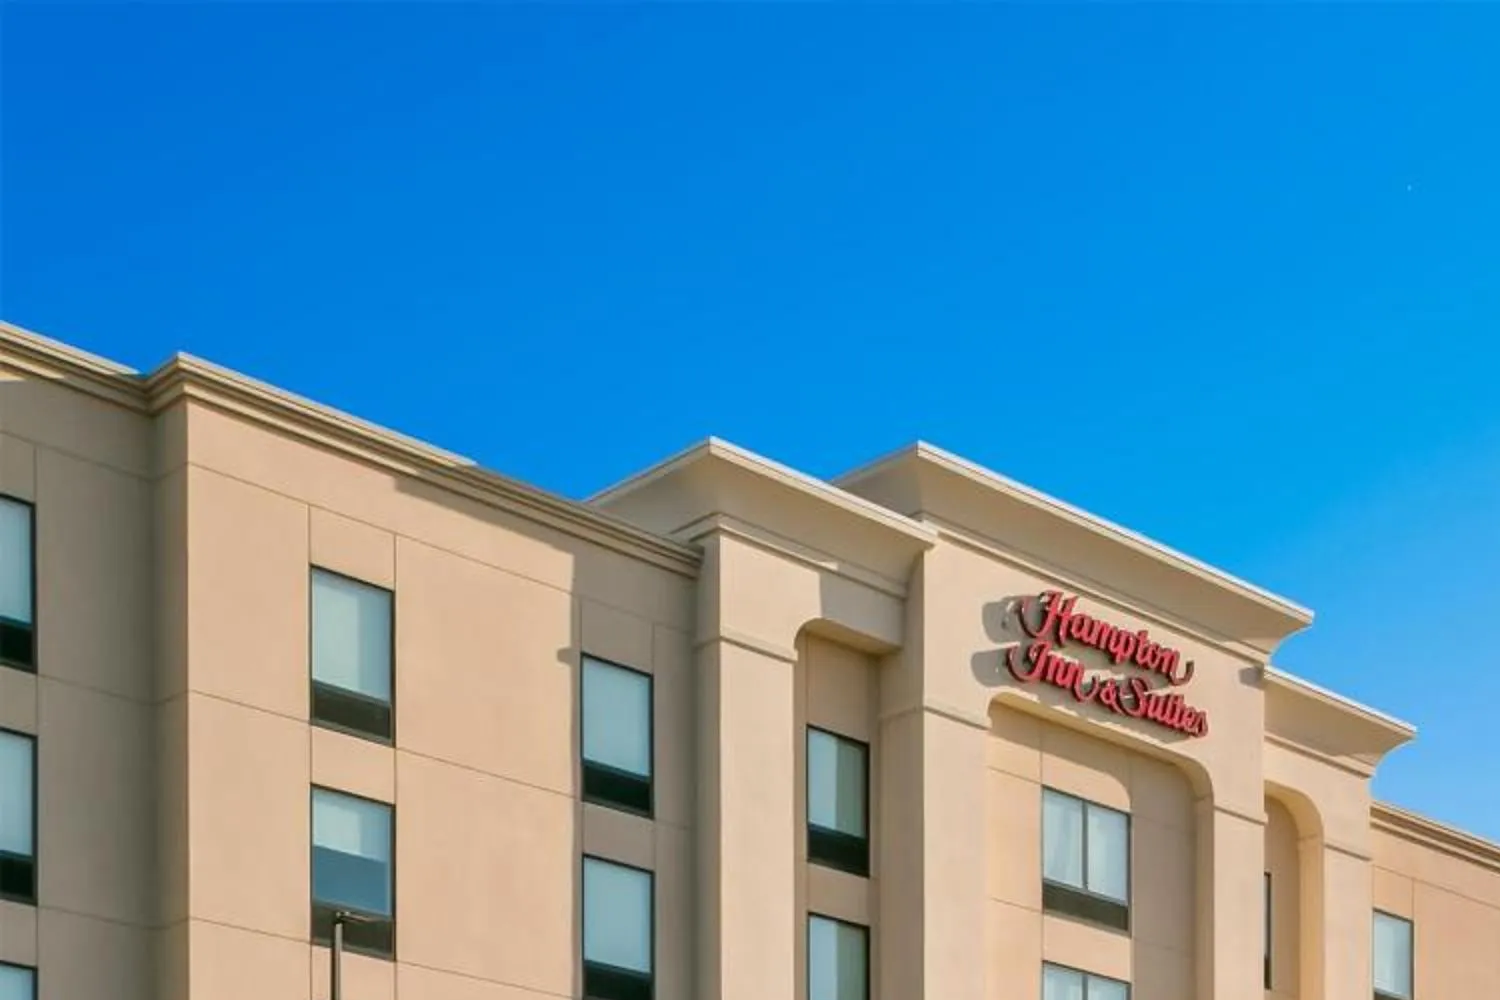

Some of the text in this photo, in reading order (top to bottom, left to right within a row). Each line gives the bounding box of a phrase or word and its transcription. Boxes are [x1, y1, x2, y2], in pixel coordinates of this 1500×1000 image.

[1010, 589, 1195, 686] Hampton
[1006, 641, 1099, 702] Inn
[1117, 676, 1209, 738] Suites
